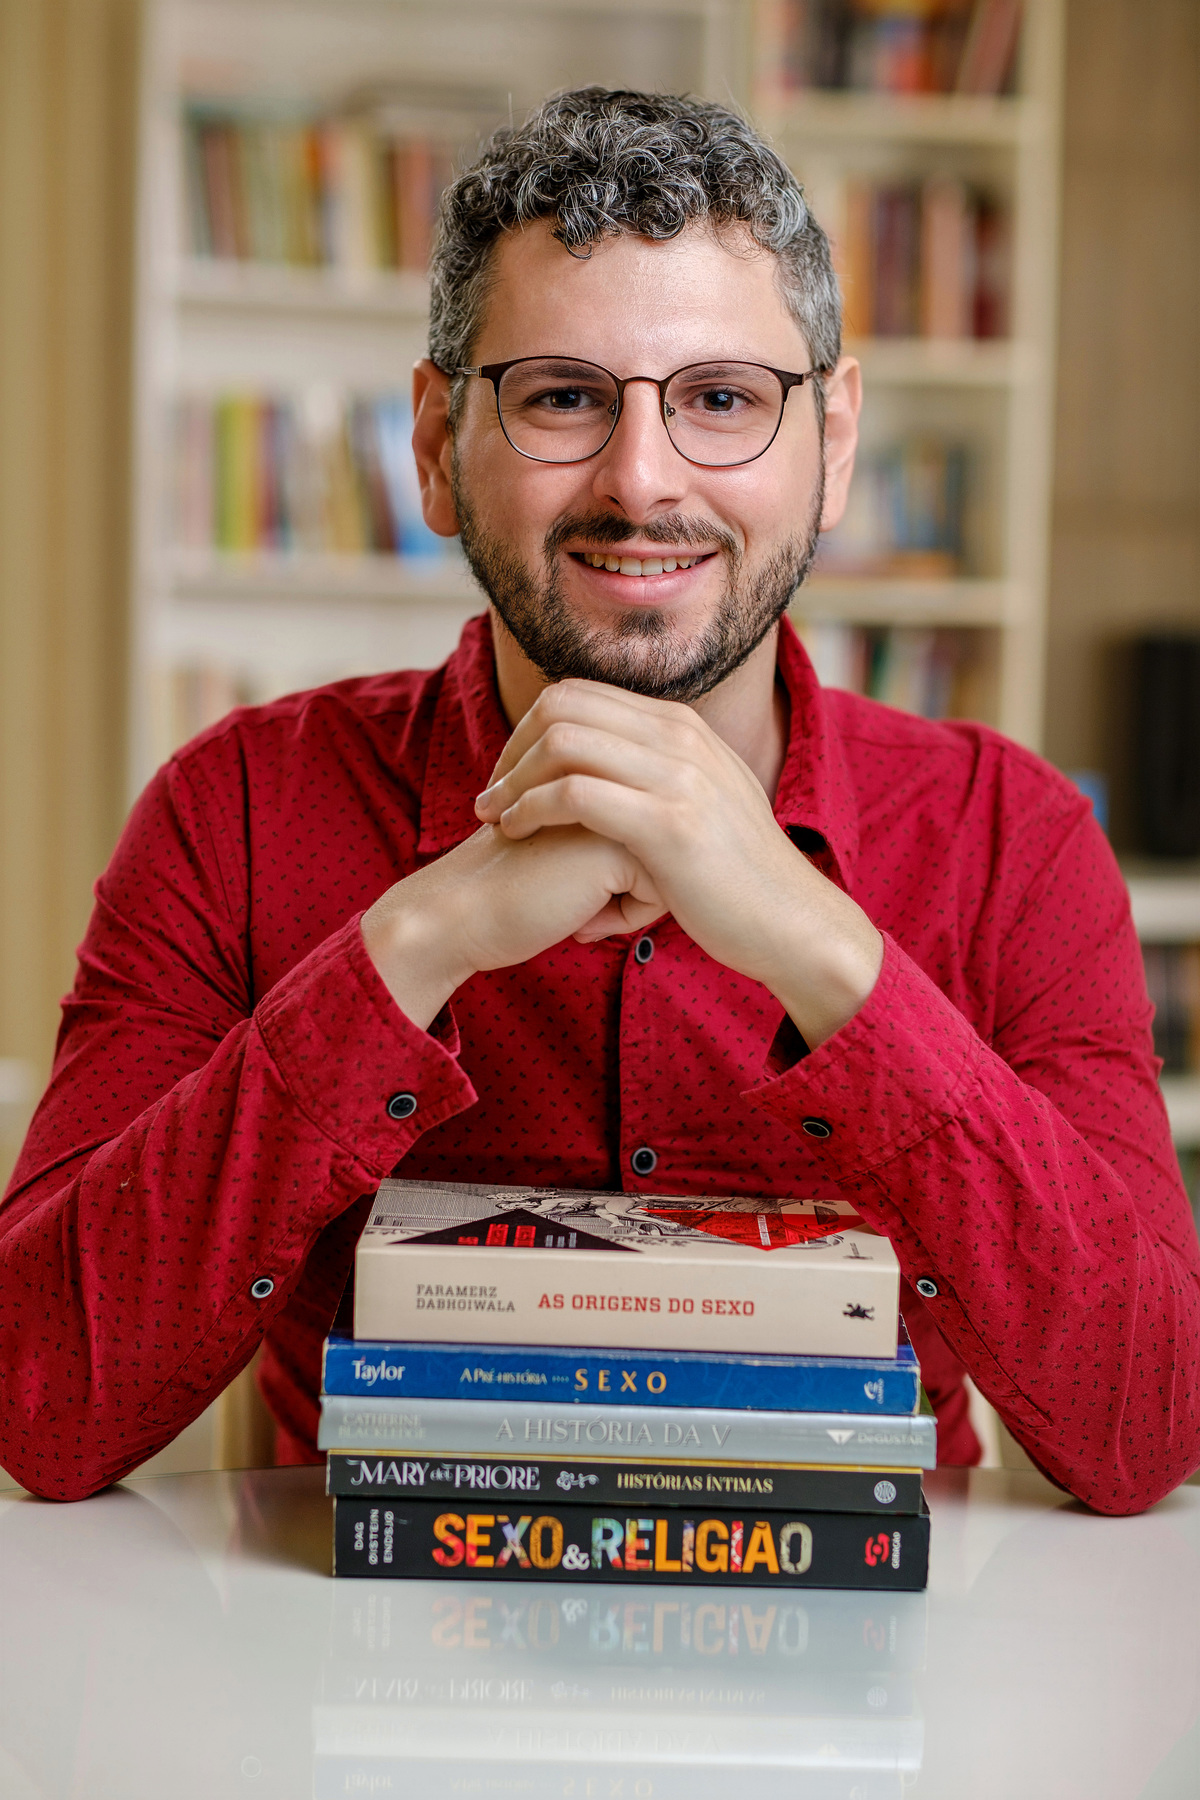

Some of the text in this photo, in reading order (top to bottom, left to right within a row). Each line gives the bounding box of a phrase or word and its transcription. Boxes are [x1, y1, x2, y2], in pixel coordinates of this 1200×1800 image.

[416, 1284, 497, 1298] FARAMERZ
[538, 1293, 755, 1316] AS ORIGENS DO SEXO
[416, 1298, 516, 1312] DABHOIWALA
[352, 1360, 405, 1386] Taylor
[459, 1367, 472, 1383] A
[574, 1368, 667, 1395] SEXO
[495, 1416, 732, 1447] A HISTÓRIA DA V
[346, 1458, 430, 1486] MARY
[450, 1463, 540, 1490] PRIORE
[617, 1472, 773, 1494] HISTÓRIAS ÍNTIMAS
[354, 1522, 364, 1550] DAG
[431, 1513, 813, 1575] SEXO & RELIGIÃO
